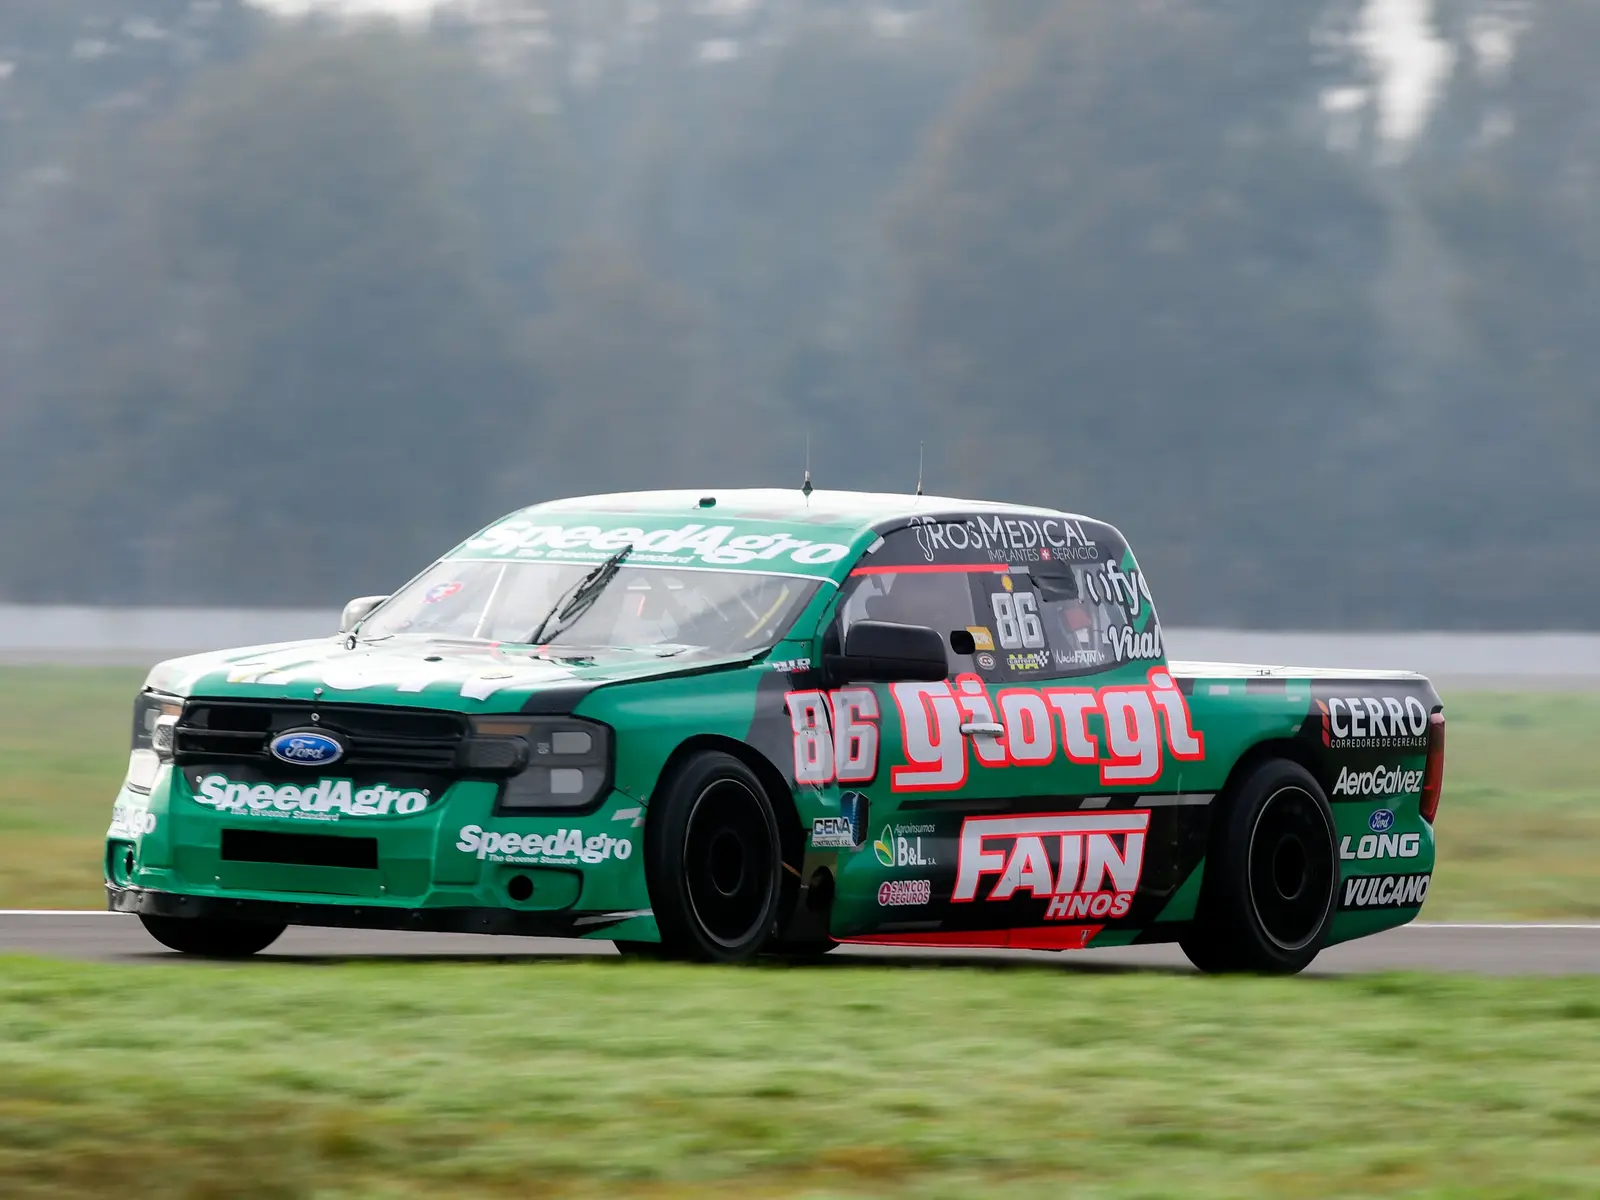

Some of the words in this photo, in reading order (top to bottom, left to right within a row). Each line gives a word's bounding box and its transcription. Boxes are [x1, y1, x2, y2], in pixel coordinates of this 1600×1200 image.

[466, 520, 850, 565] SpeedAgro
[988, 548, 1040, 562] IMPLANTES
[1052, 547, 1099, 560] SERVICIO
[991, 592, 1045, 649] 86
[1328, 696, 1428, 738] CERRO
[285, 738, 326, 759] Ford
[785, 687, 880, 785] 86
[1330, 738, 1380, 748] CORREDORES
[1381, 738, 1391, 747] DE
[1392, 737, 1427, 747] CEREALES
[1332, 765, 1423, 795] AeroGalvez
[194, 776, 428, 816] SpeedAgro
[894, 823, 936, 836] Agroinsumos
[1371, 811, 1391, 829] Ford
[456, 824, 633, 864] SpeedAgro
[898, 836, 927, 867] B&L
[950, 810, 1151, 903] FAIN
[1340, 833, 1420, 860] LONG
[890, 892, 930, 905] SEGUROS
[891, 881, 931, 893] SANCOR
[1344, 874, 1431, 907] VULCANO
[1044, 893, 1132, 921] HNOS
